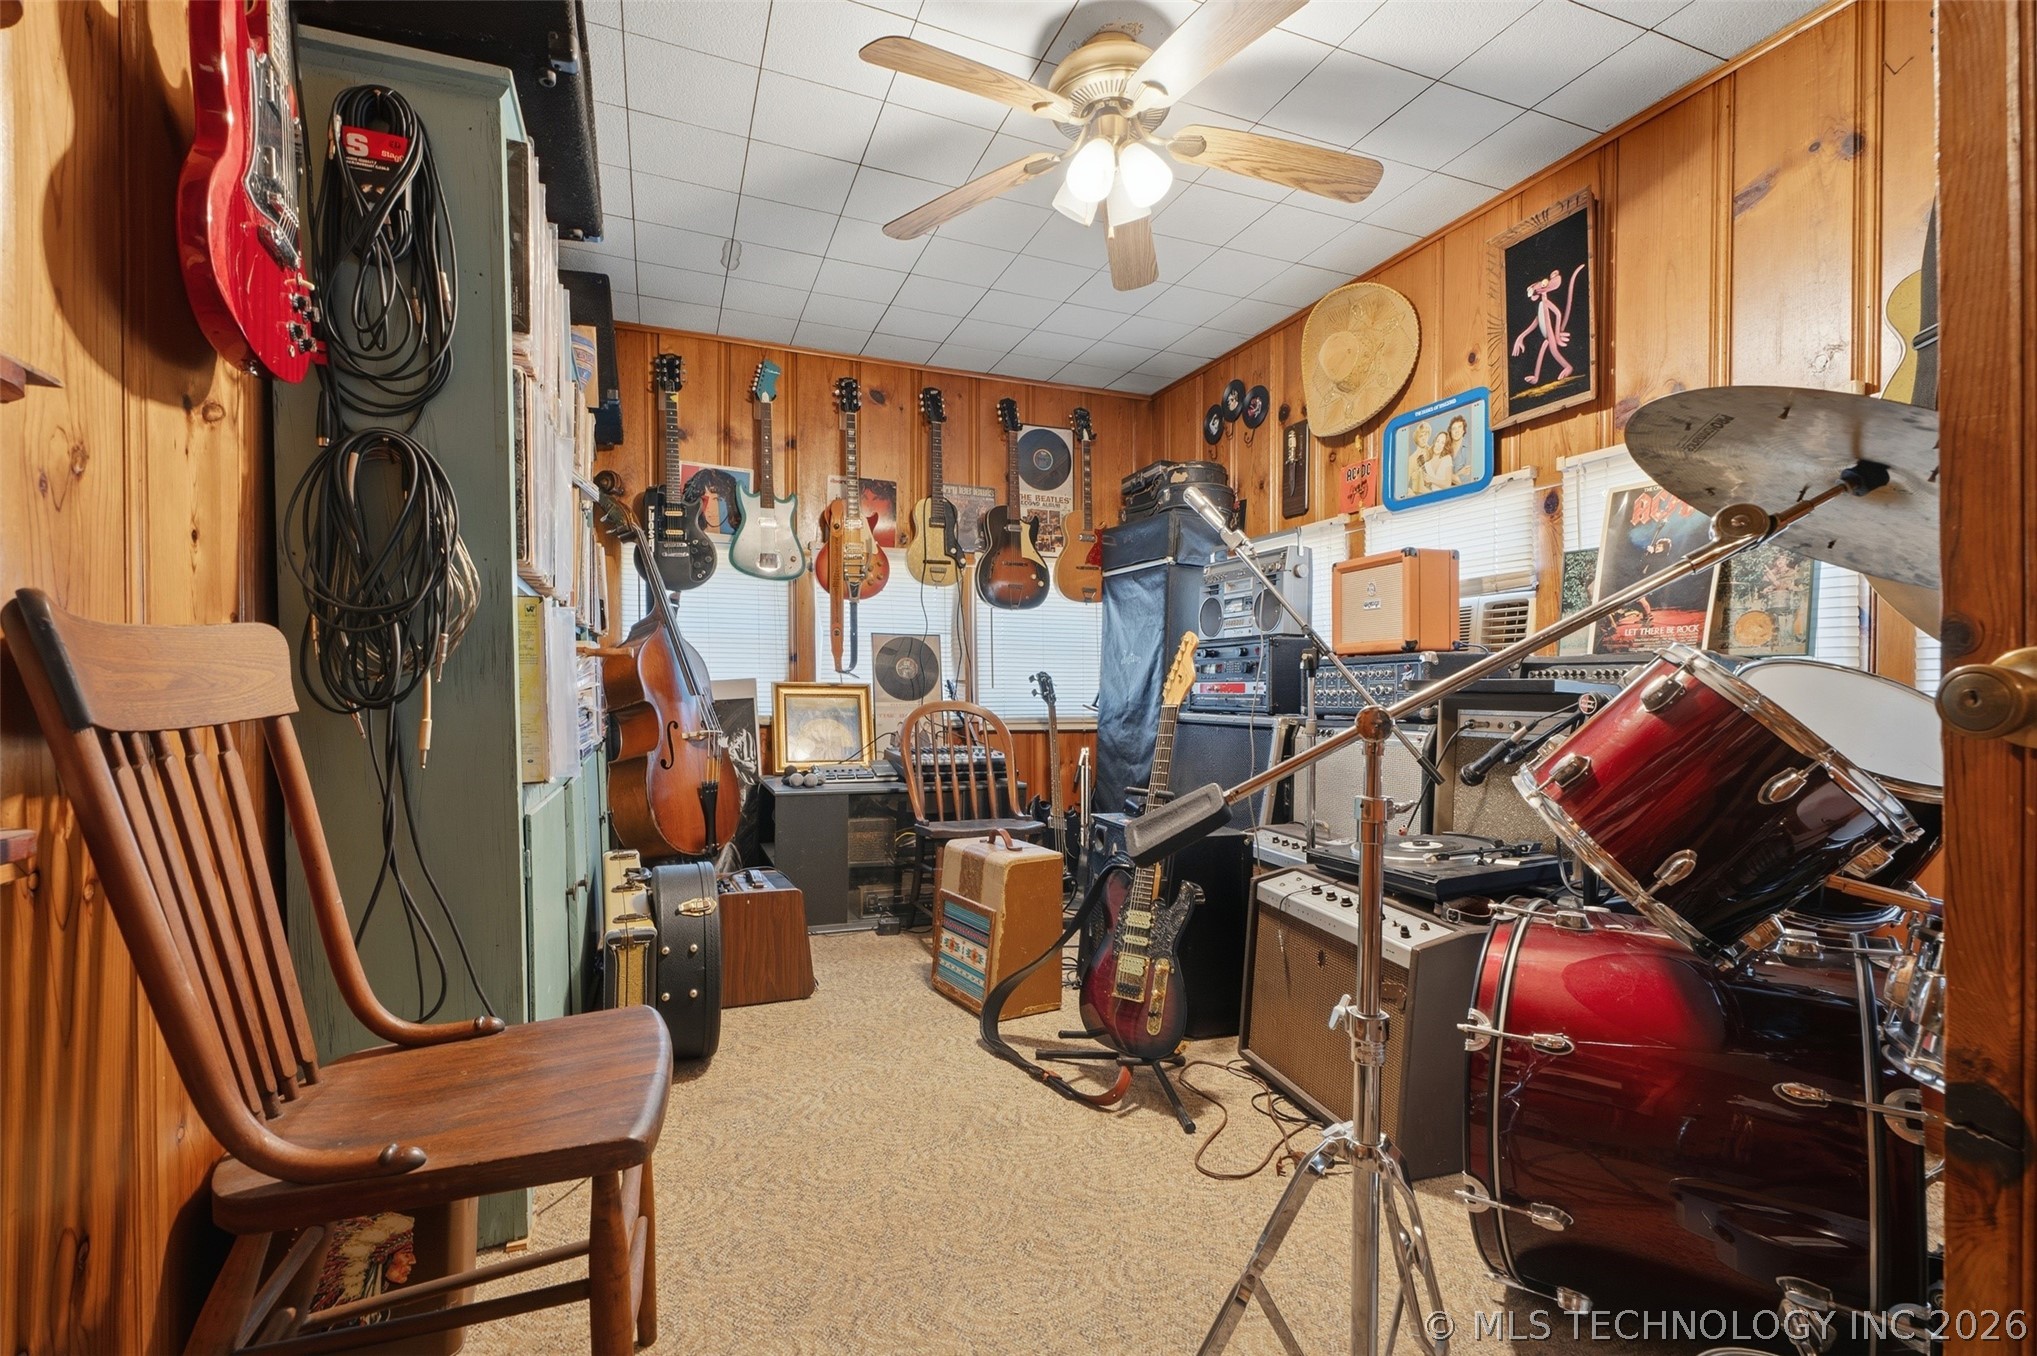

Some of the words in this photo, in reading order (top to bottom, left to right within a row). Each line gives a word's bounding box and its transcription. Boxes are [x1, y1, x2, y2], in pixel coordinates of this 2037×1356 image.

[346, 132, 369, 157] S
[1624, 627, 1639, 637] LET
[1640, 626, 1665, 636] THERE
[1666, 626, 1675, 634] BE
[1676, 624, 1700, 633] ROCK
